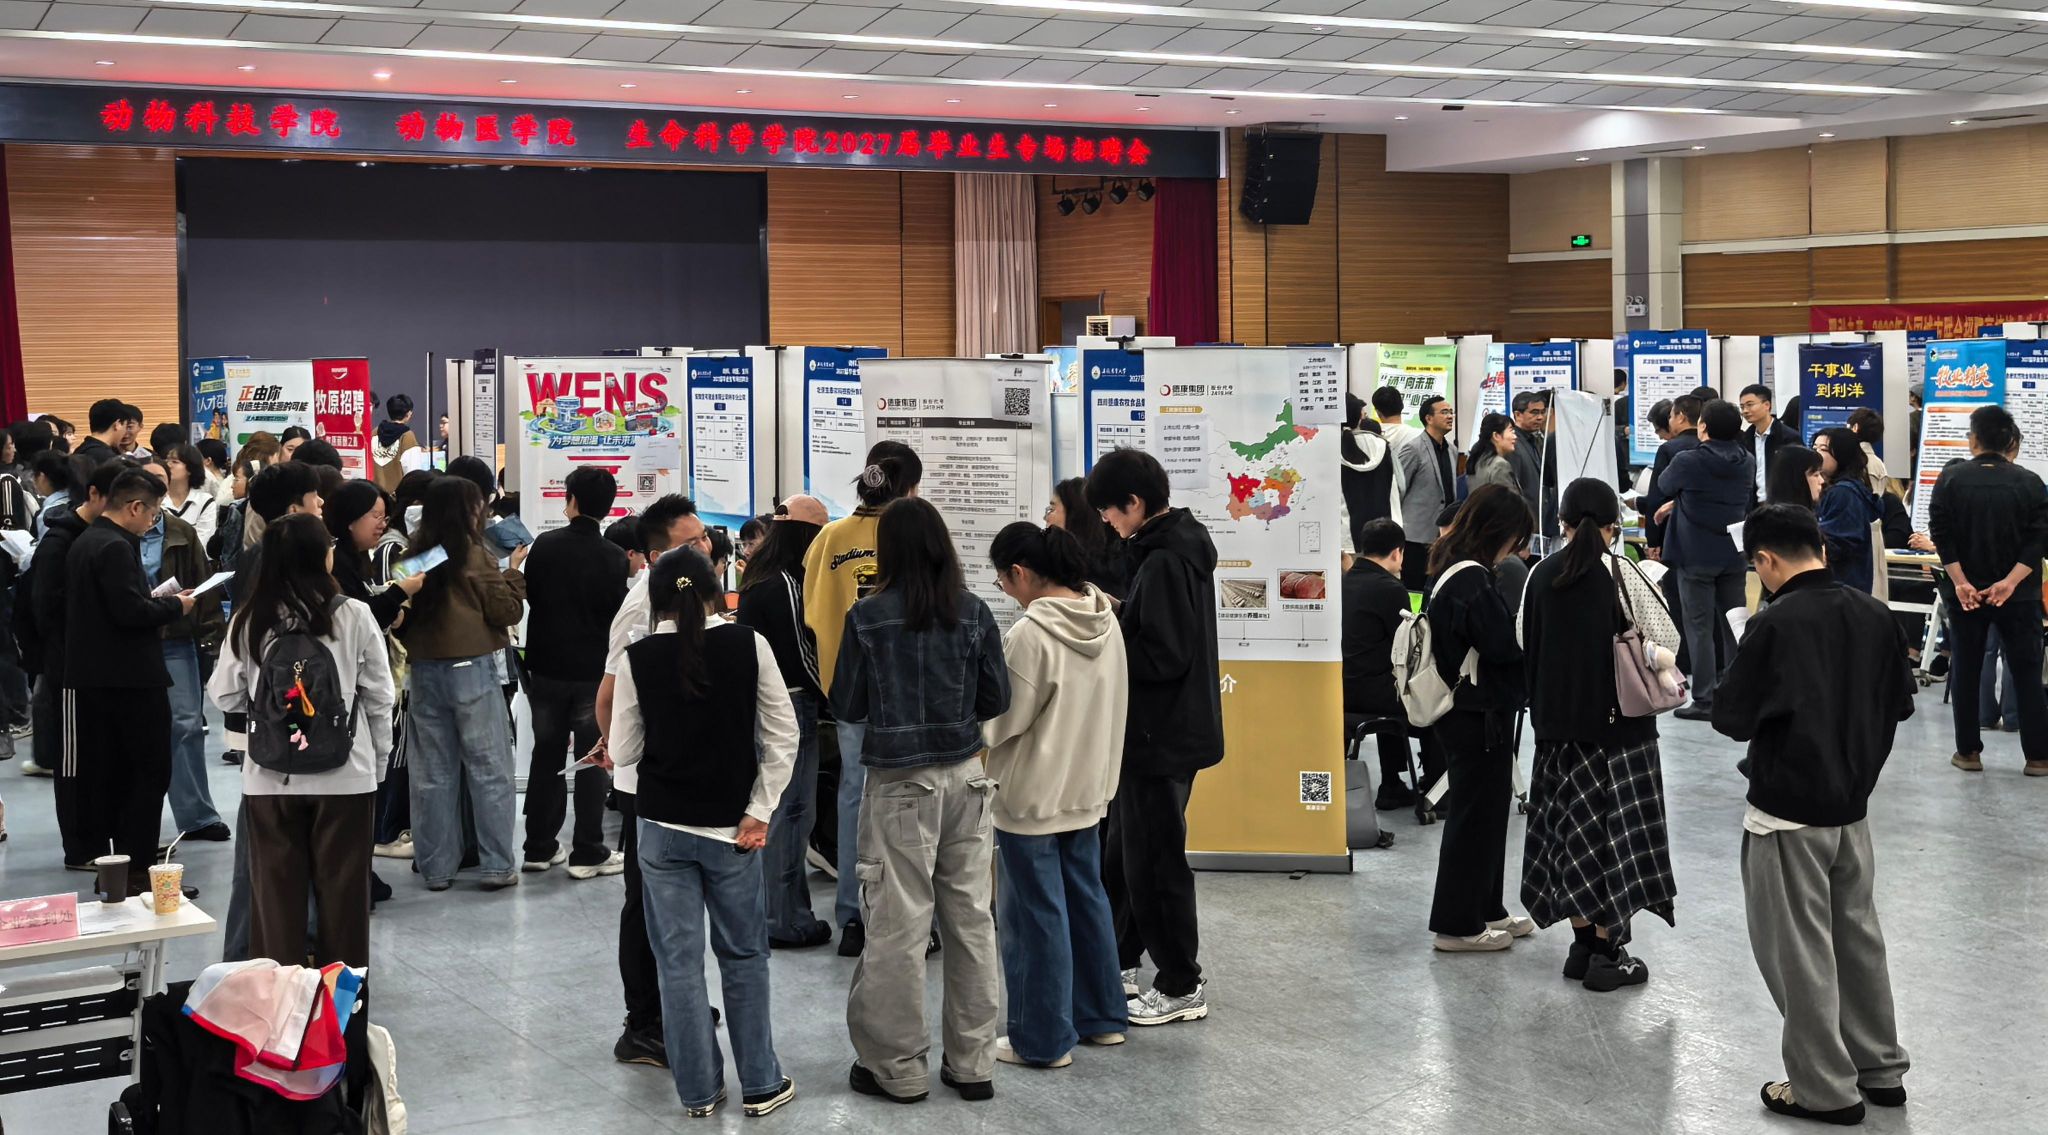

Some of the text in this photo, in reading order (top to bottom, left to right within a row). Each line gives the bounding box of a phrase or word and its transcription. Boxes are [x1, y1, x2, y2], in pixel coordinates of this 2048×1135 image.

[100, 98, 1152, 166] 动物科技学院 动物医学院 生命科学学院2027届毕业生专场招聘会
[1807, 362, 1857, 379] 干事业
[239, 385, 283, 401] 正由你
[526, 373, 669, 417] WENS
[1172, 385, 1205, 393] 德康集团
[1814, 382, 1866, 399] 到利洋
[315, 389, 364, 416] 牧原招聘
[830, 547, 877, 571] Stadium
